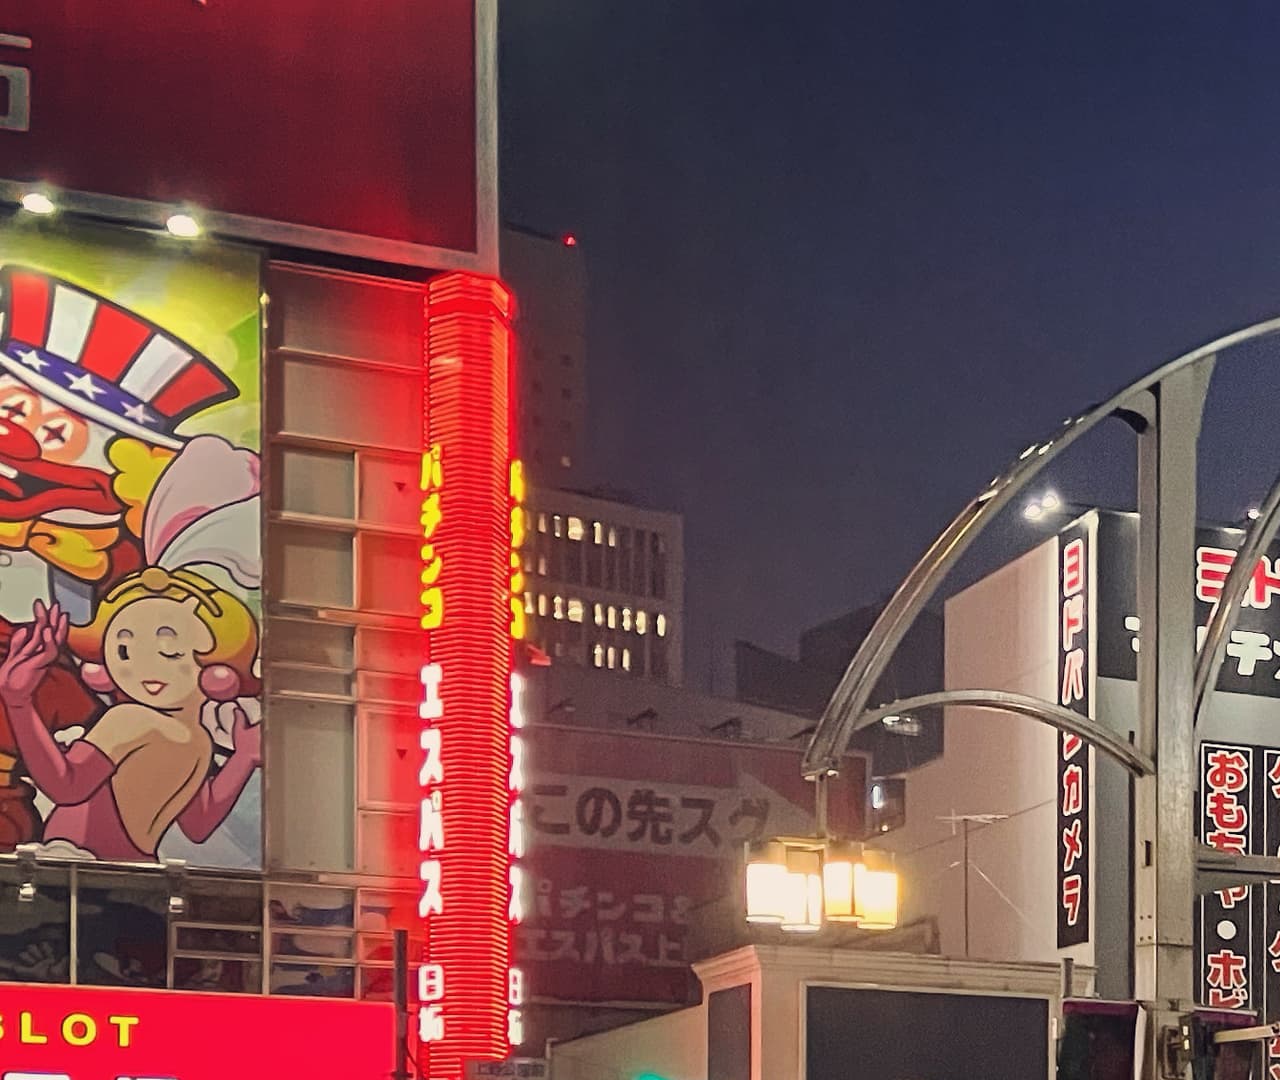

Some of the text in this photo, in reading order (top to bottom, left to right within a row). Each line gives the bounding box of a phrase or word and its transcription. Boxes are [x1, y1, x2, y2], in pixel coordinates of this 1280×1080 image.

[418, 665, 444, 918] エスパス
[0, 1009, 140, 1048] LOT
